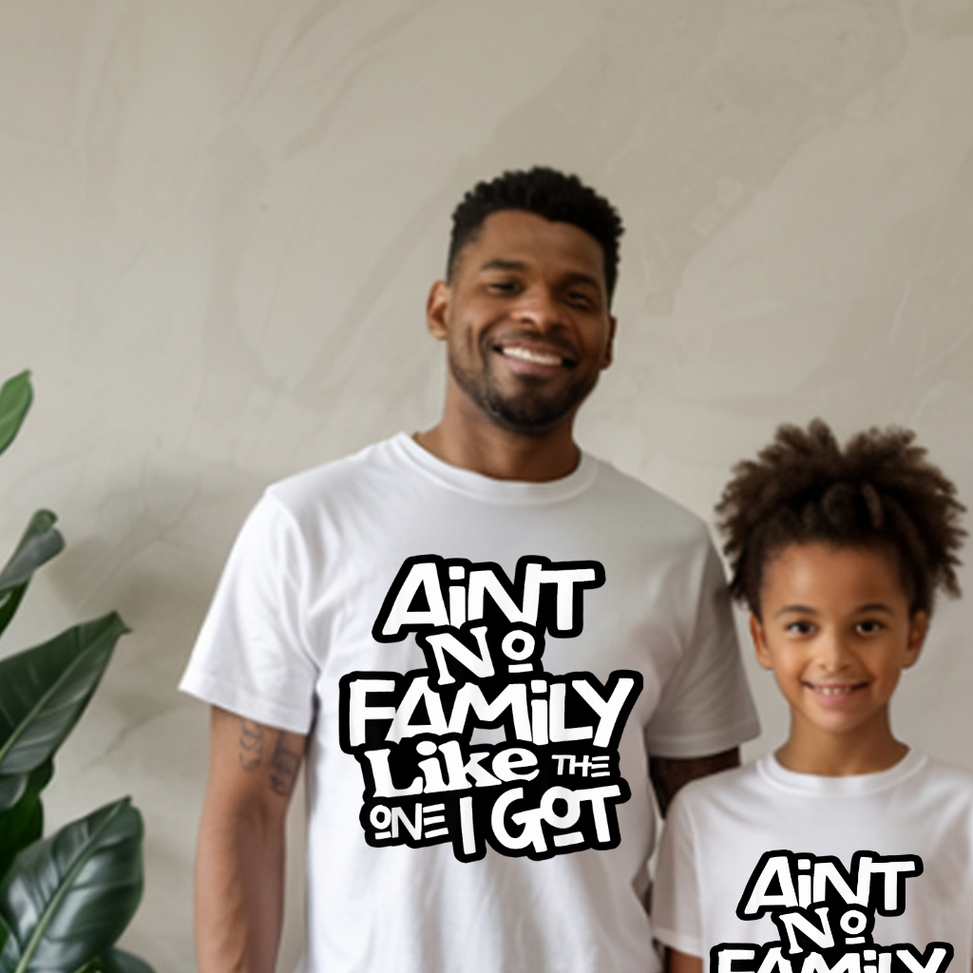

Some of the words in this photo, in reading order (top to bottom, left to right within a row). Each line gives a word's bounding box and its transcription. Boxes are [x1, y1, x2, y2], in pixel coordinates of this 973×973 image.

[363, 739, 541, 799] Like
[550, 753, 612, 778] THE
[368, 801, 450, 841] ONE
[490, 783, 622, 854] GOT
